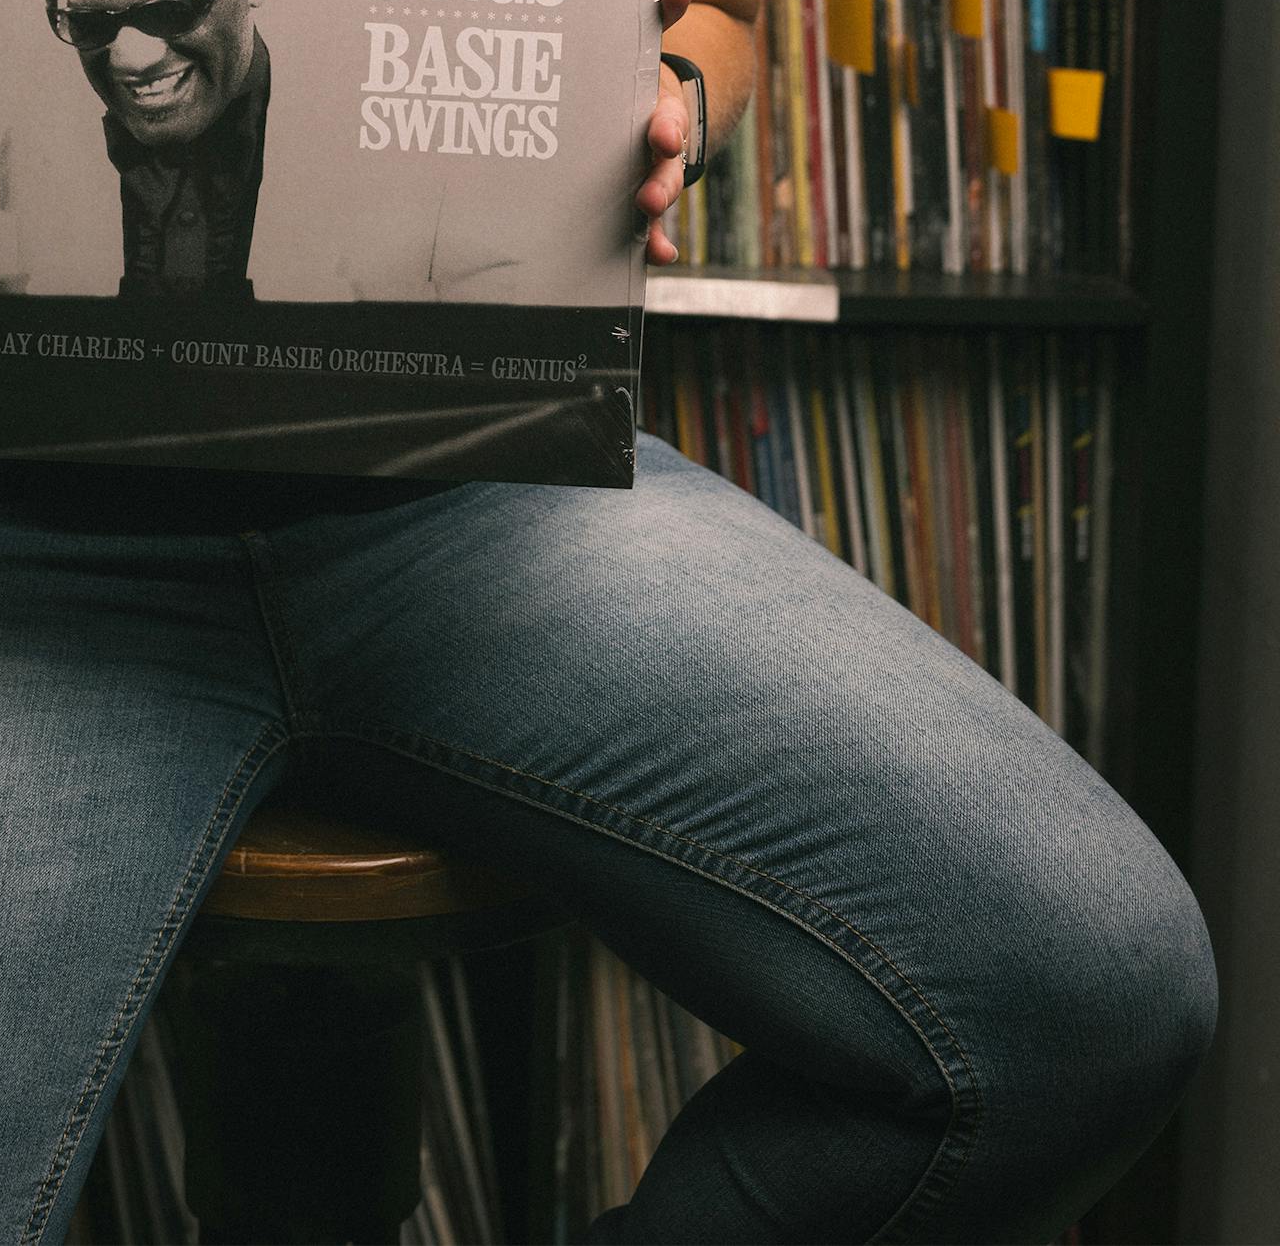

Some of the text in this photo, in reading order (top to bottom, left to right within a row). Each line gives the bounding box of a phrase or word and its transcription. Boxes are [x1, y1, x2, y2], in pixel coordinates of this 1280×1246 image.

[360, 22, 563, 101] BASIE
[359, 96, 558, 160] SWINGS
[38, 333, 145, 361] CHARLES
[171, 340, 248, 366] COUNT
[255, 344, 323, 370] BASIE
[329, 348, 465, 377] ORCHESTRA
